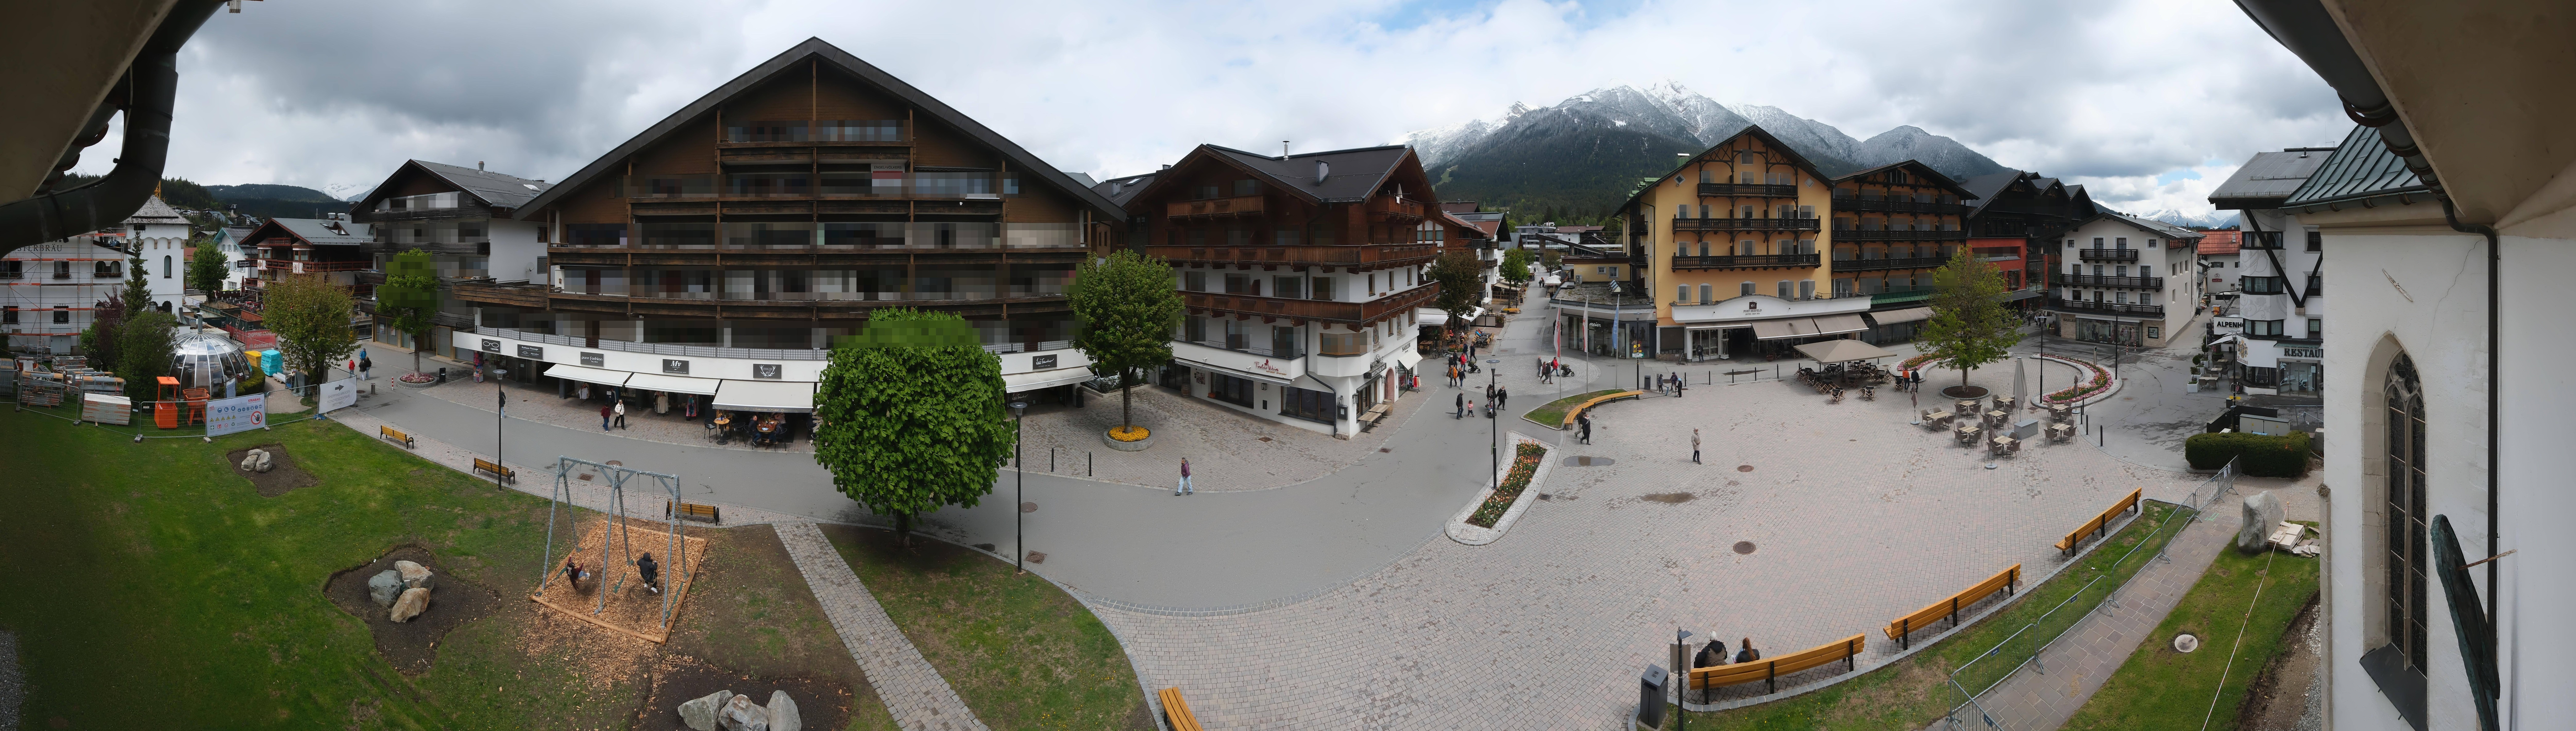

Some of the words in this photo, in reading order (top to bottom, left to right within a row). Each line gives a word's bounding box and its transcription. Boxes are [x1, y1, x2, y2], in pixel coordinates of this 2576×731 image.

[1402, 343, 1410, 352] SAILER
[670, 361, 681, 370] My
[1371, 364, 1385, 377] RESTAURANT
[327, 395, 350, 403] KONGRESSZENTRUM
